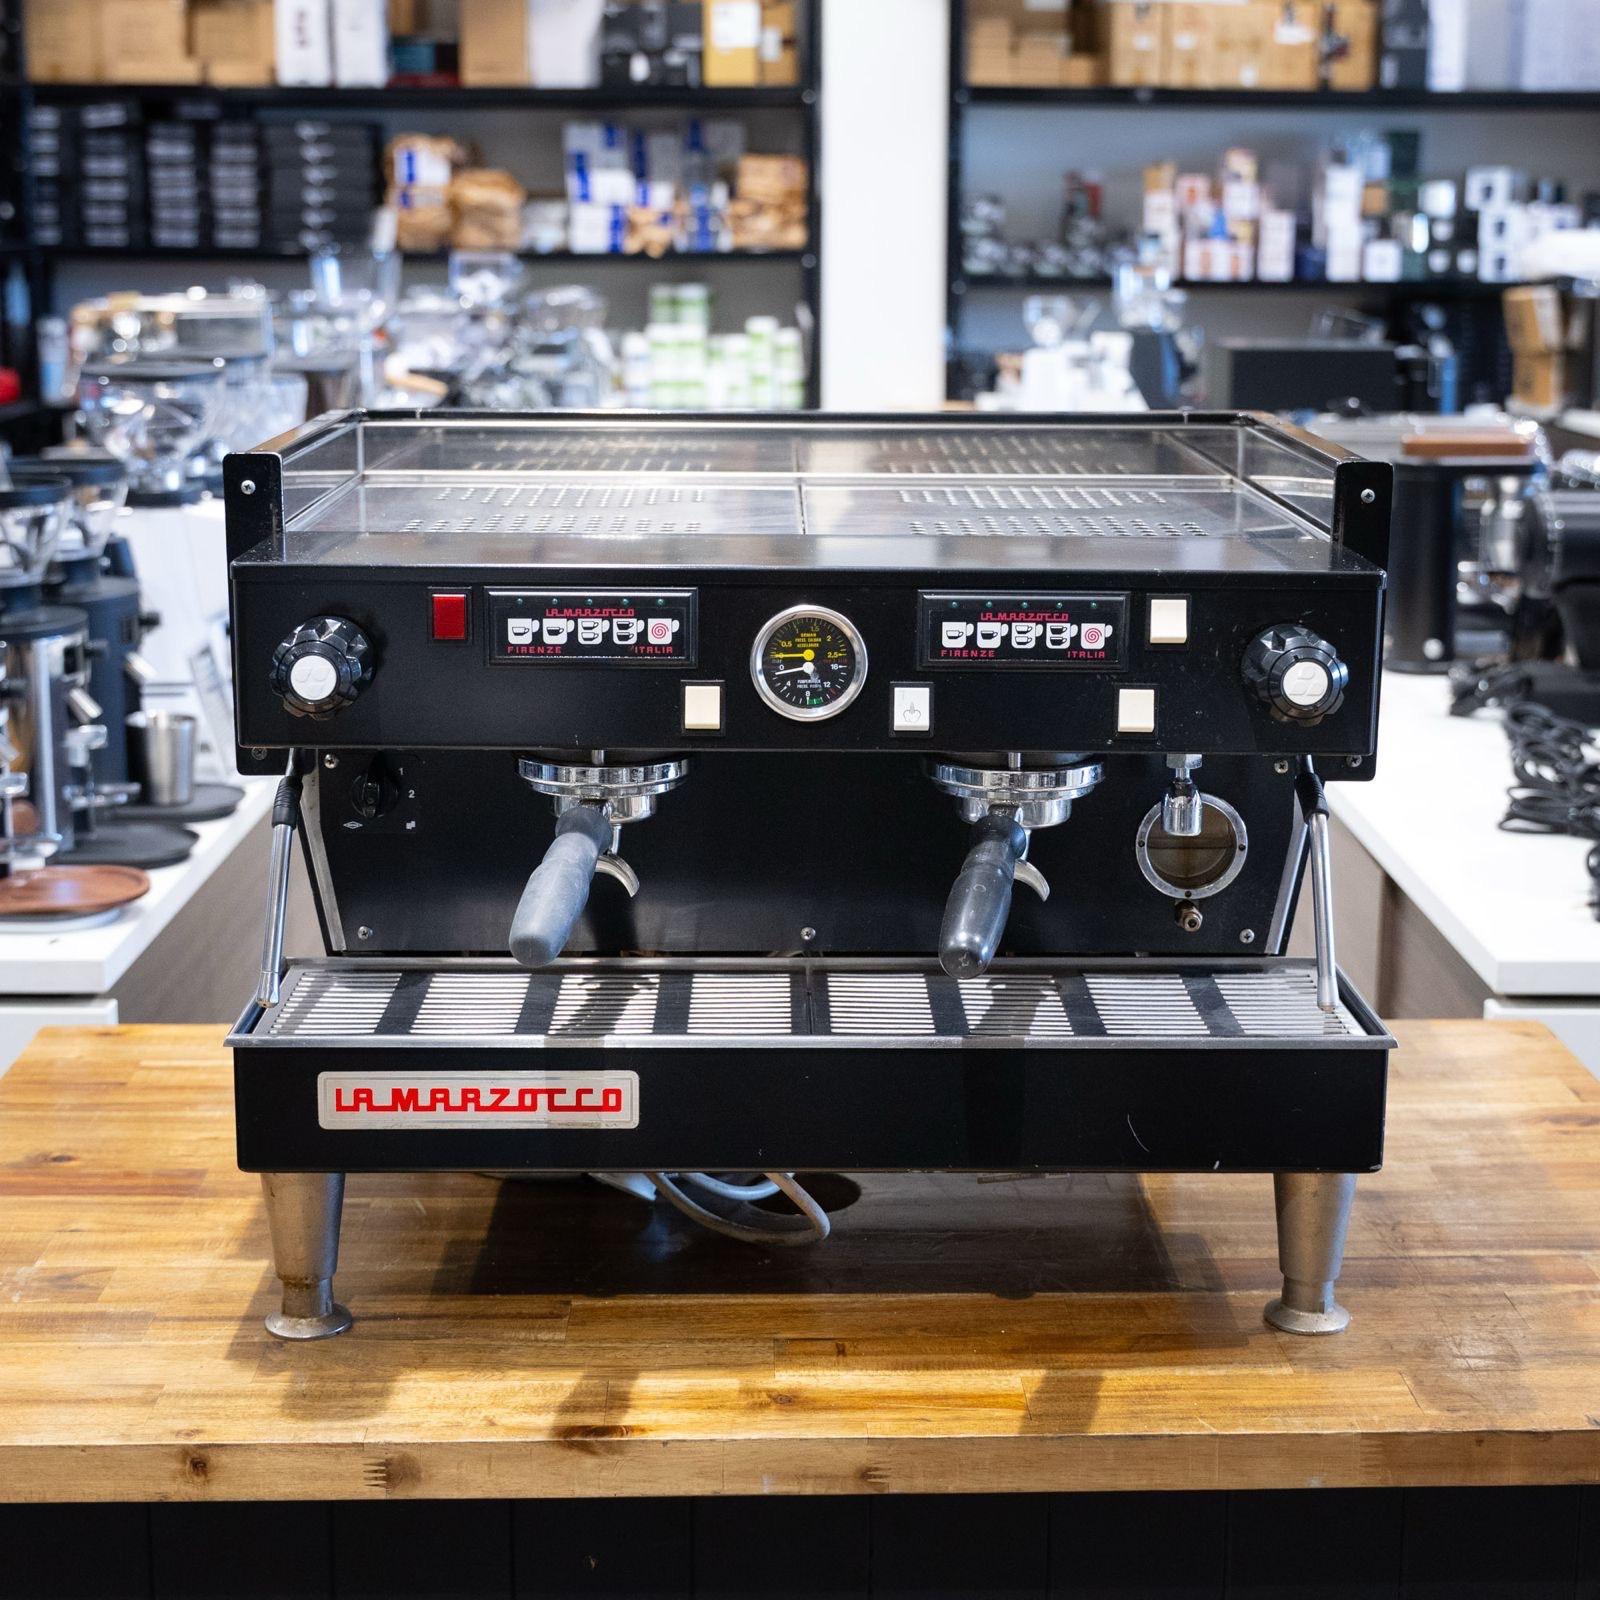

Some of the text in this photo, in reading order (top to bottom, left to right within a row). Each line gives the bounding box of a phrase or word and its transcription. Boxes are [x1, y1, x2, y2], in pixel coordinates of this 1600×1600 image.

[563, 608, 635, 617] MARZOCCO
[998, 613, 1069, 621] MARZOCCO
[507, 646, 562, 654] FIRENZE
[634, 646, 673, 654] ITALIA
[408, 789, 415, 798] 2
[335, 1088, 622, 1112] LA MARZOCCO
